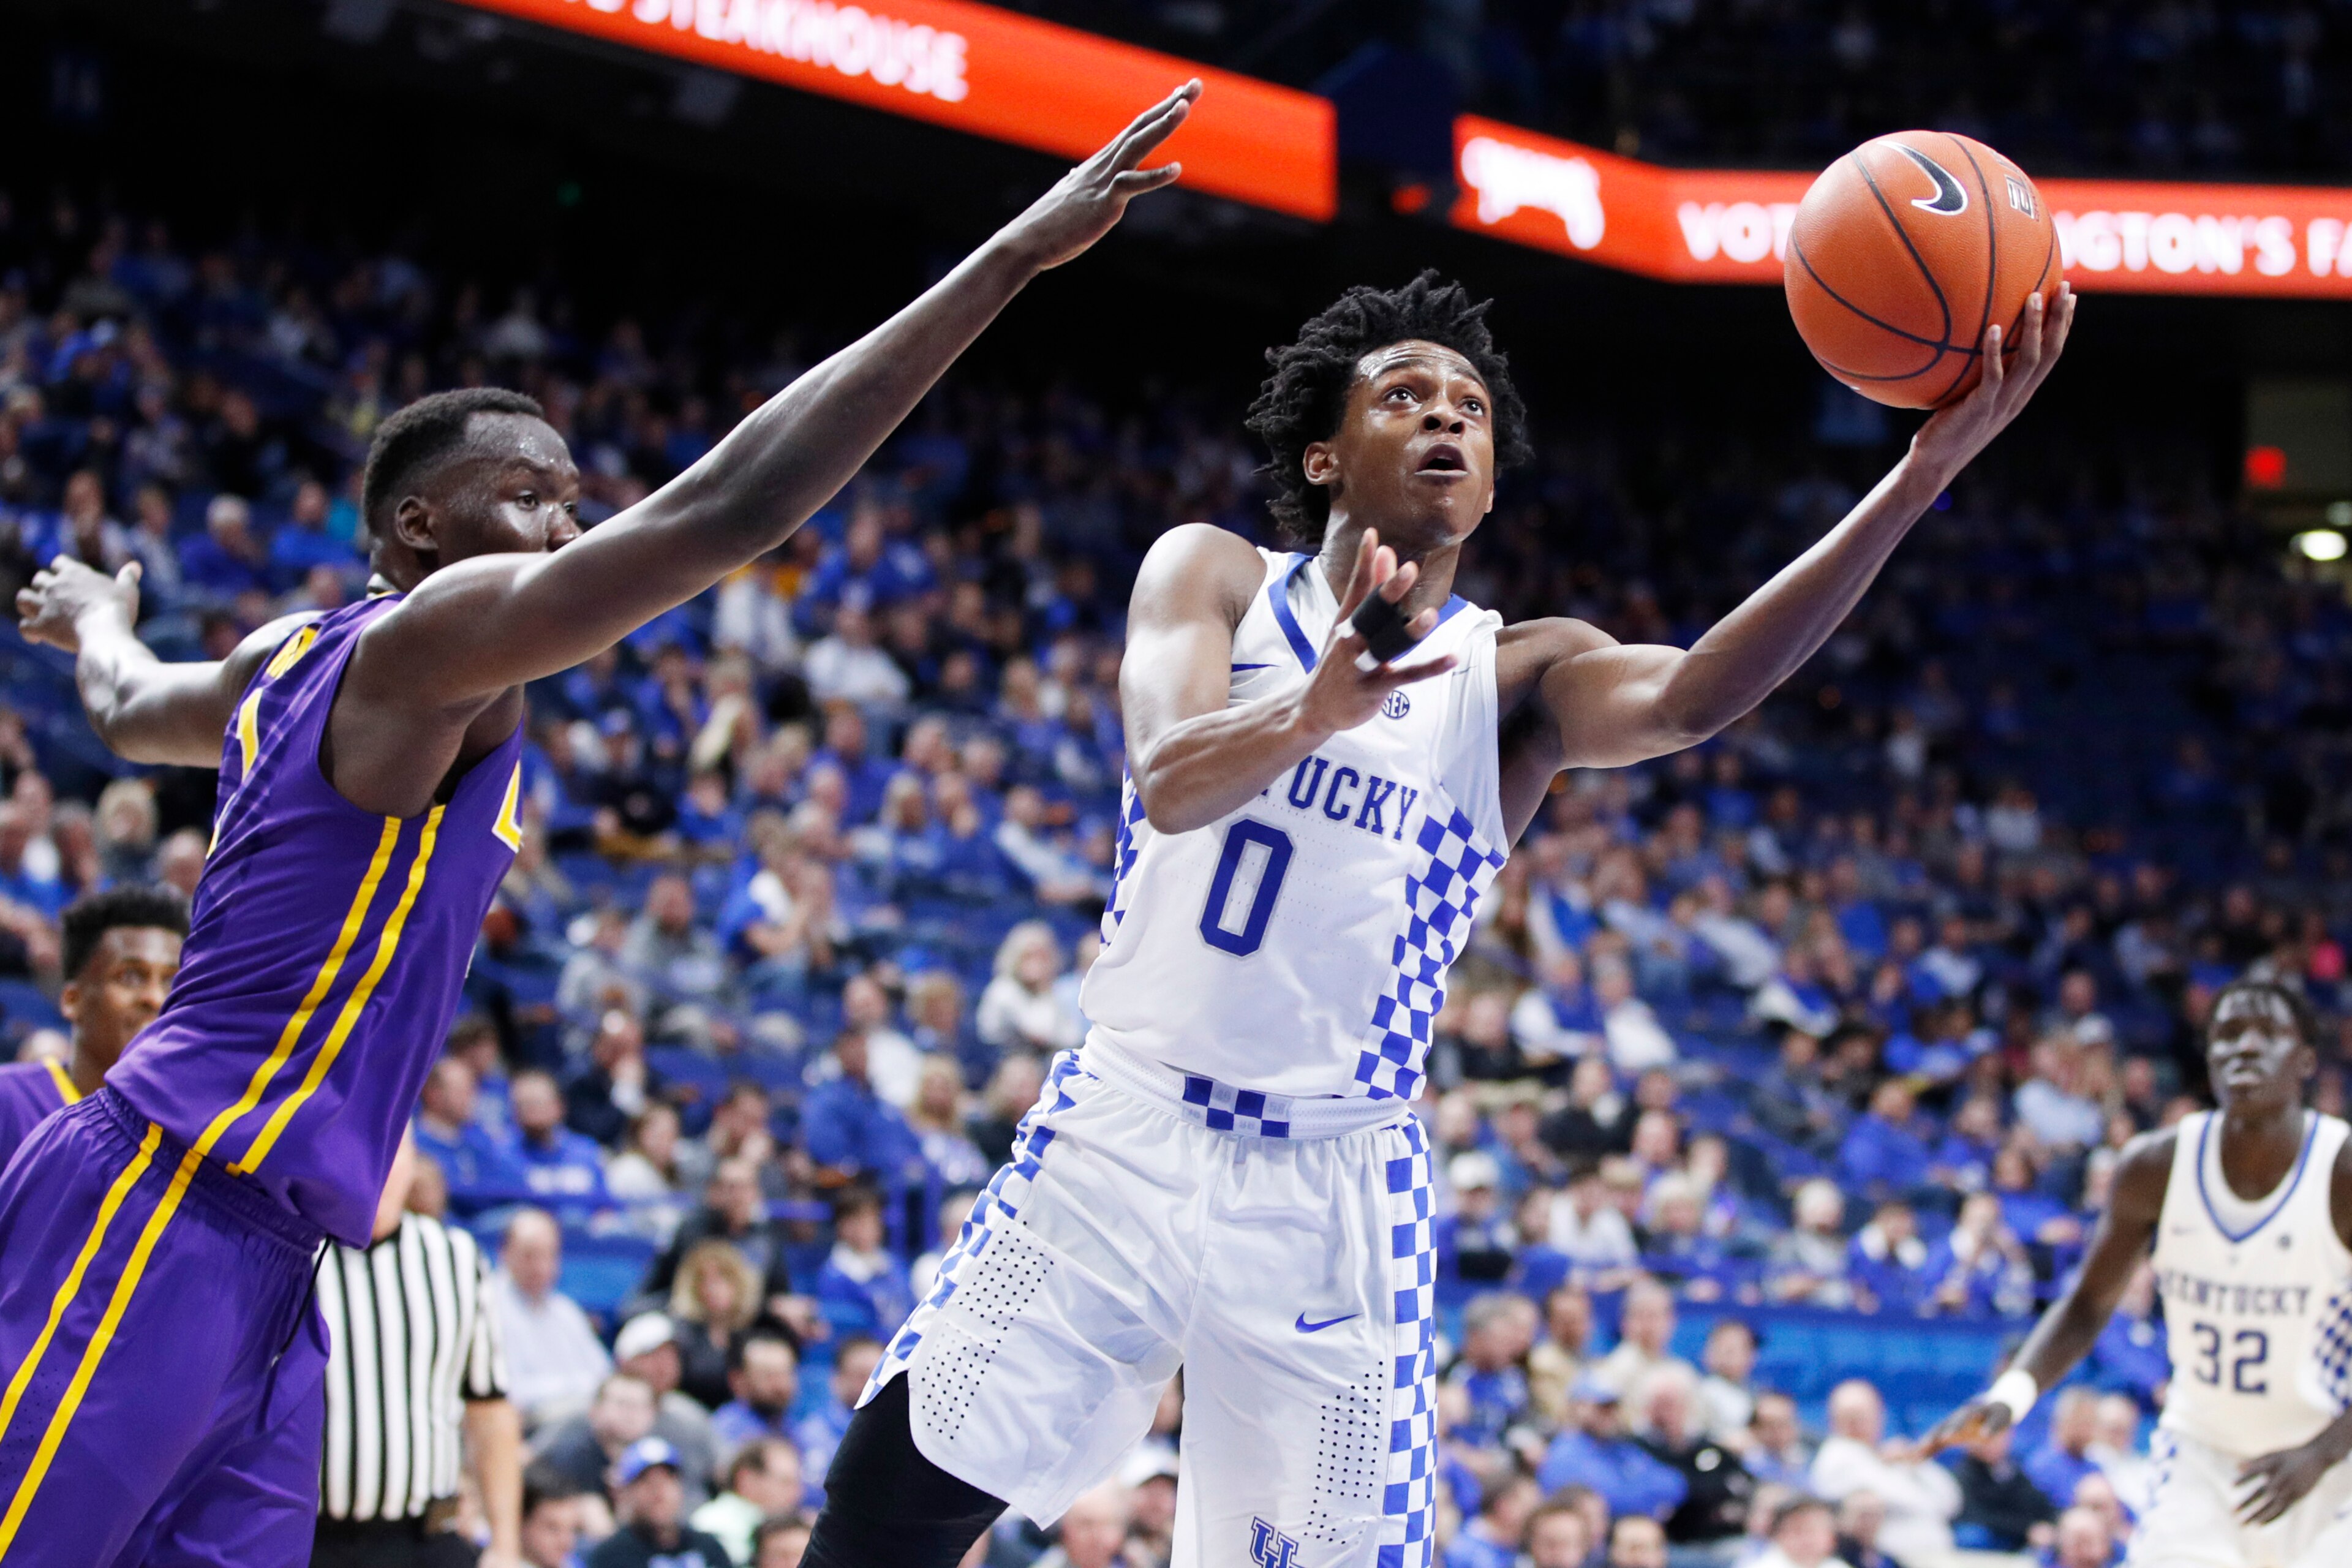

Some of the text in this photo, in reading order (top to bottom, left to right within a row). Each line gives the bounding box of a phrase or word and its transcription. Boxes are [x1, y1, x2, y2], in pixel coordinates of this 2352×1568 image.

[1262, 755, 1419, 842] UCKY
[1198, 816, 1295, 958] 0
[2192, 1321, 2269, 1395] 32
